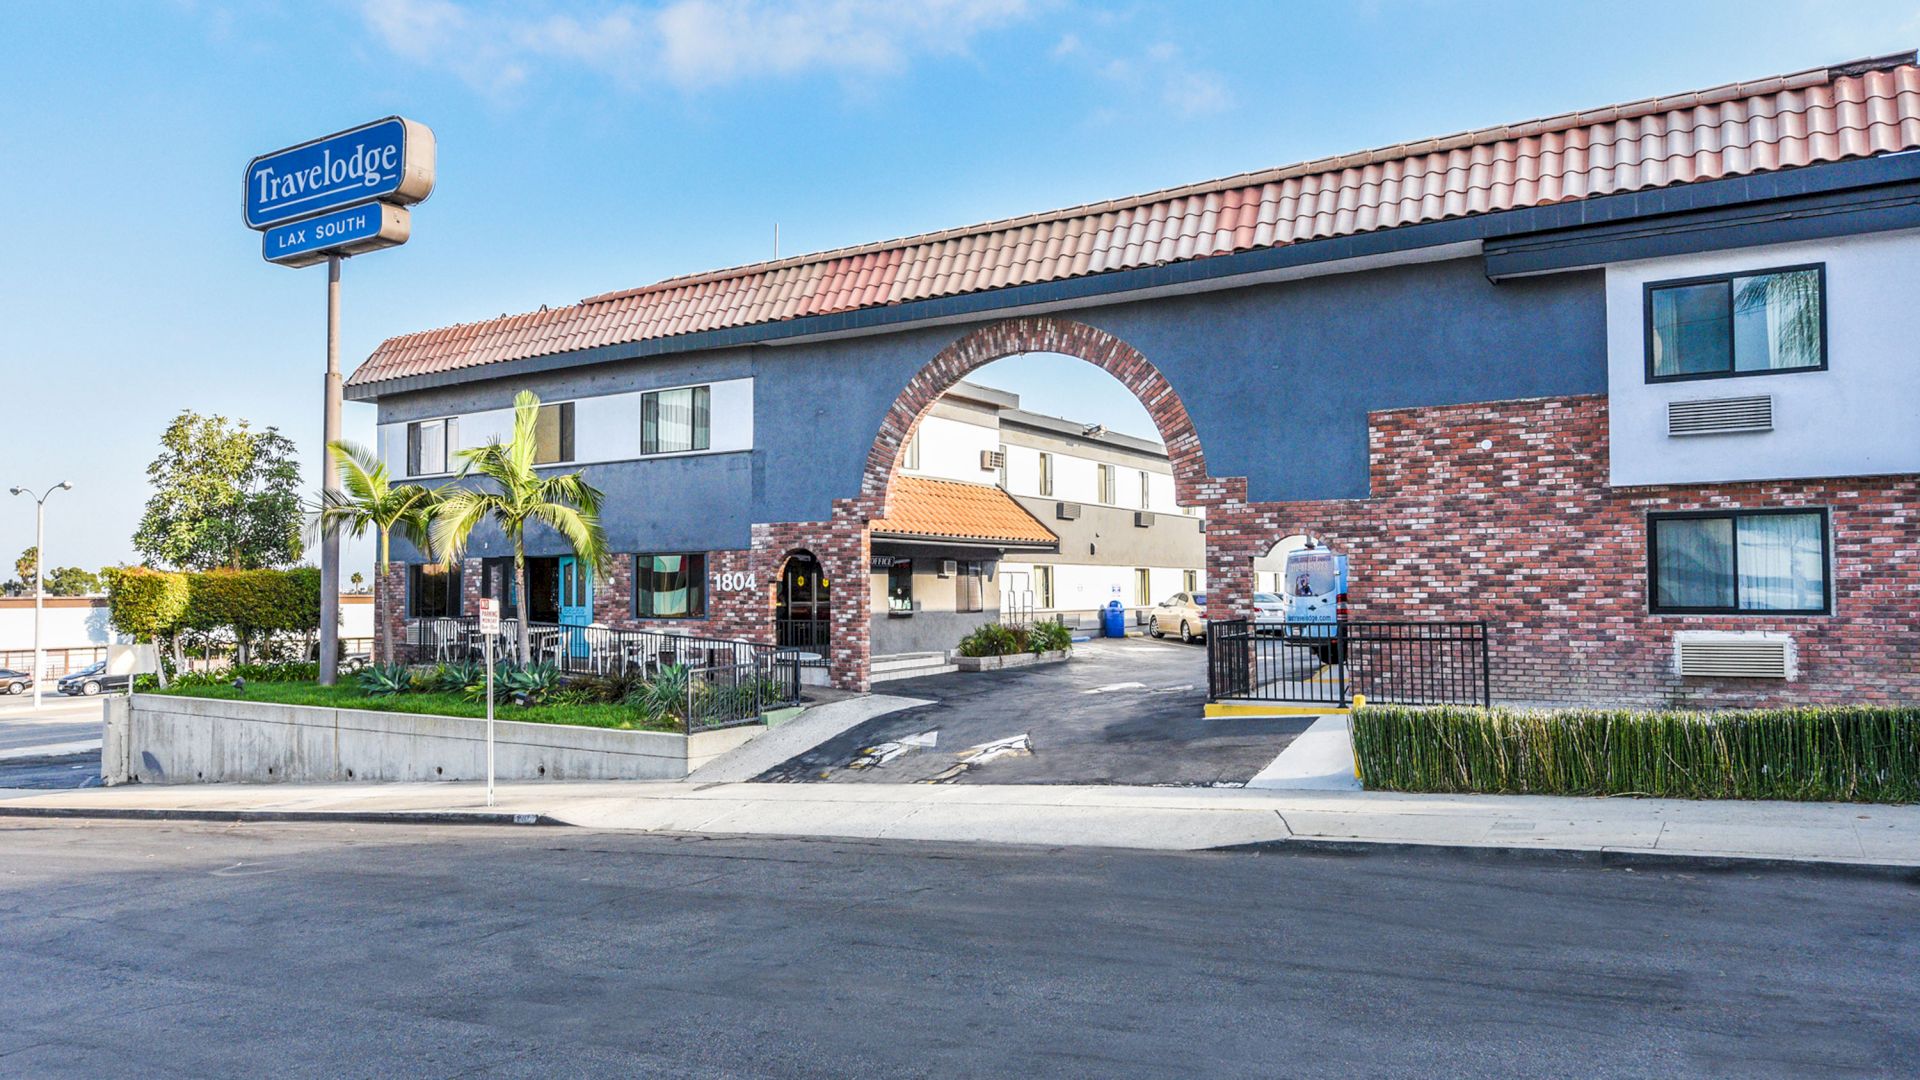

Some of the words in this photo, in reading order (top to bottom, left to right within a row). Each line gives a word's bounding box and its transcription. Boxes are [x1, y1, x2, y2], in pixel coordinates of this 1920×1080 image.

[255, 144, 397, 203] Travelodge
[279, 230, 306, 248] LAX
[316, 215, 366, 239] SOUTH
[713, 573, 757, 592] 1804
